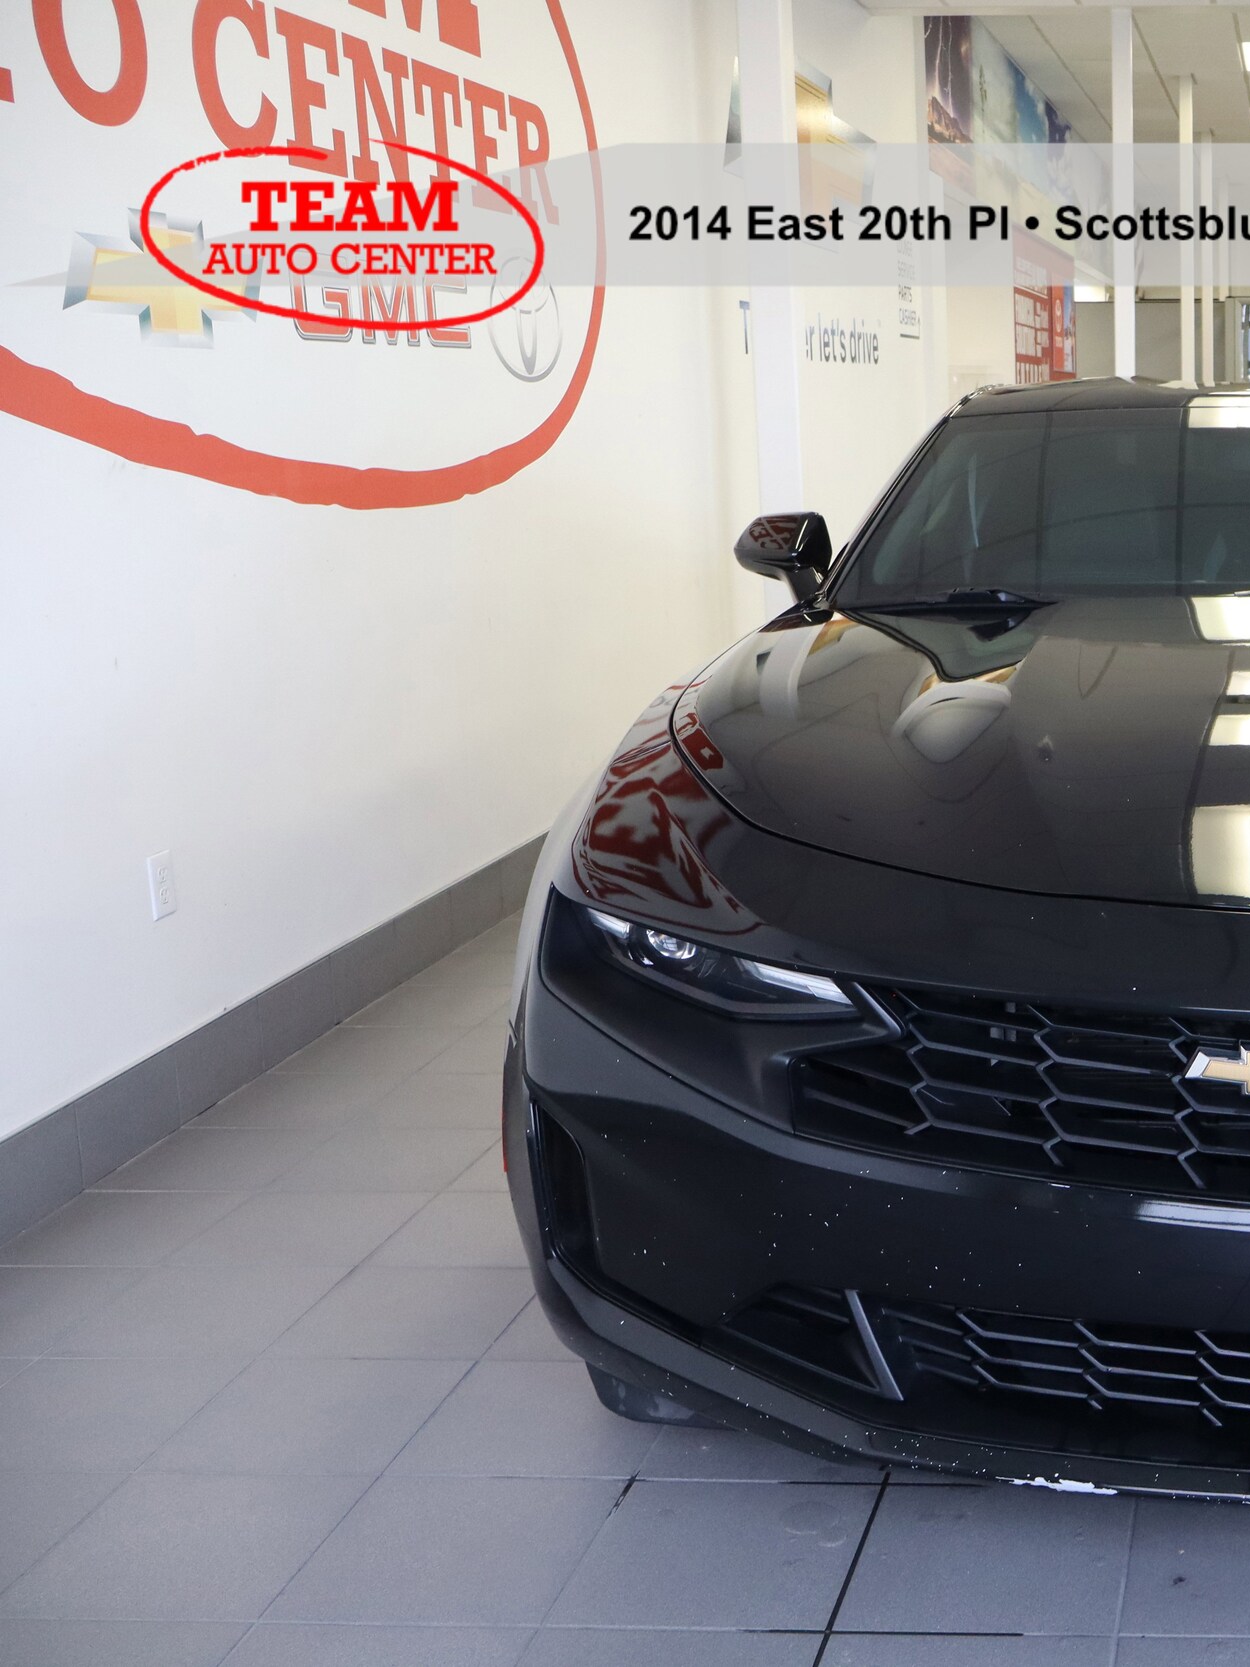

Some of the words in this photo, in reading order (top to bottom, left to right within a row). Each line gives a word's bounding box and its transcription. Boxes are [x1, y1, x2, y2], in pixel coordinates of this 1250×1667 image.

[191, 0, 560, 225] CENTER
[289, 249, 473, 348] GMC
[818, 312, 847, 363] let's
[849, 317, 879, 365] drive
